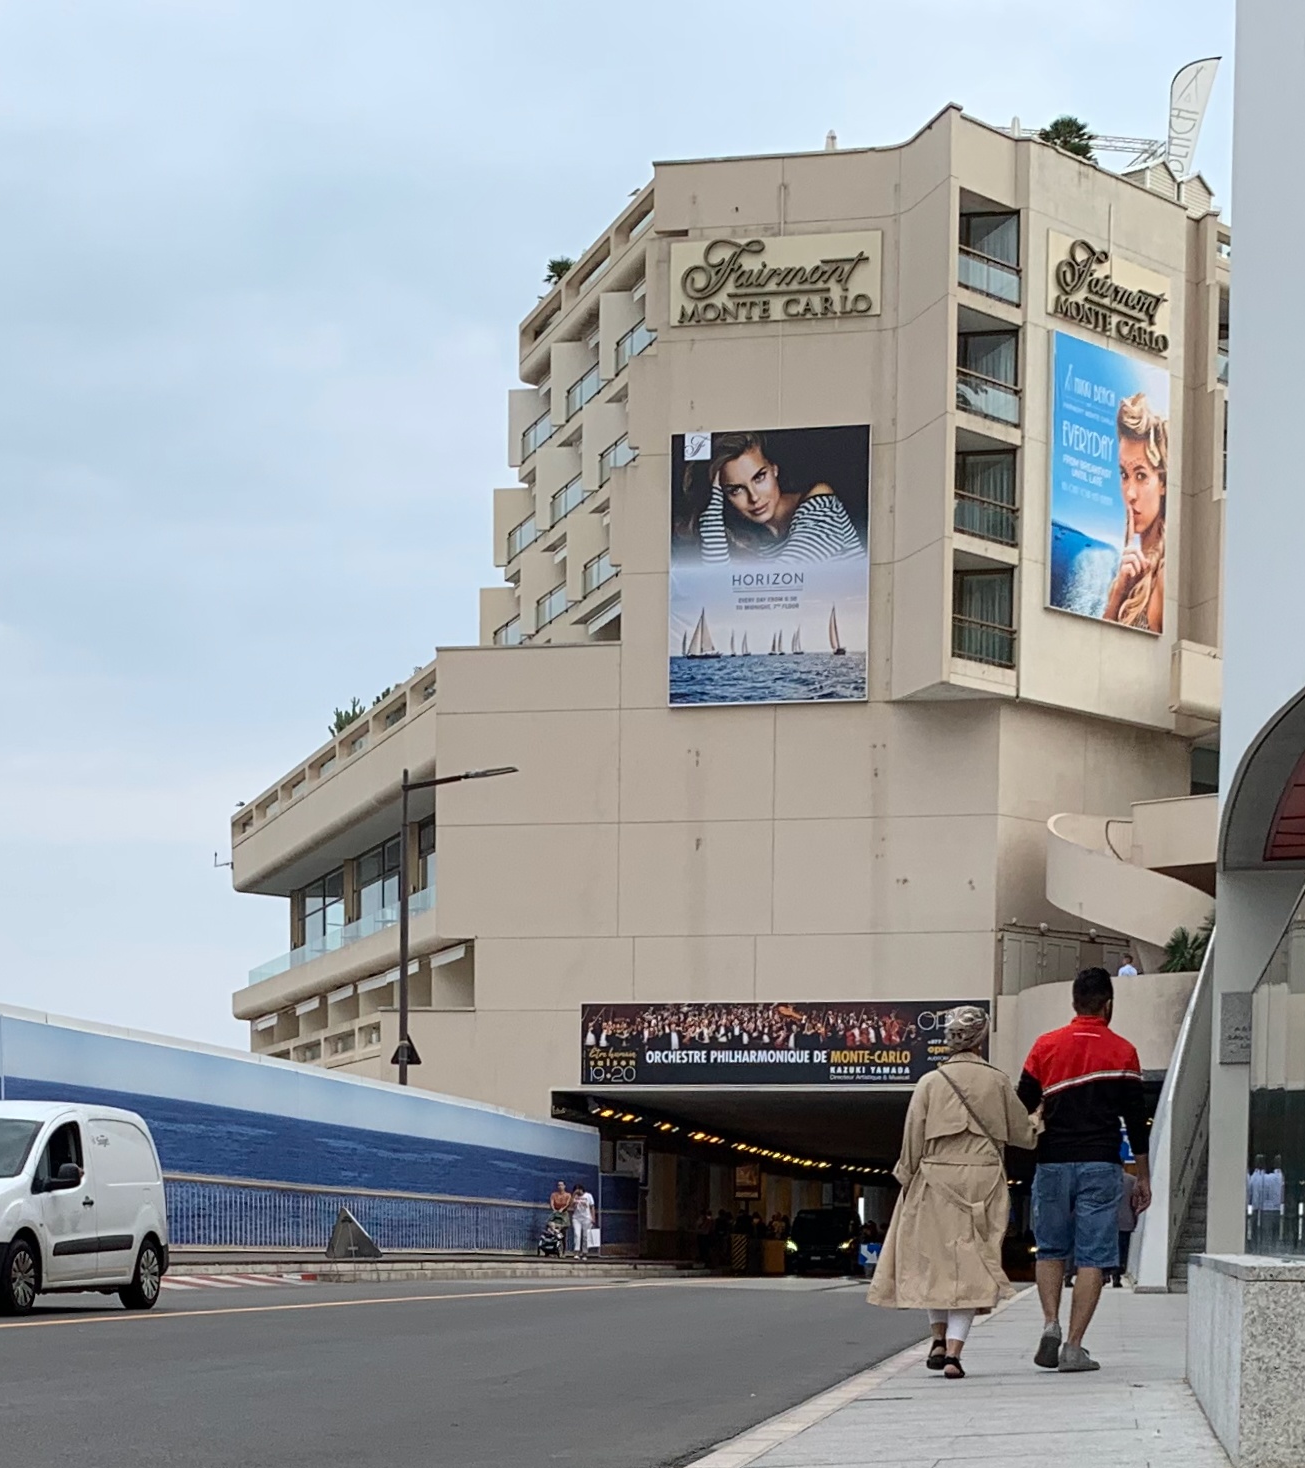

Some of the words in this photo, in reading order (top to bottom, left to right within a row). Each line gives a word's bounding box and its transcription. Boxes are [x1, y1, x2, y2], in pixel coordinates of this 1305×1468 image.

[681, 239, 870, 301] Fairmont
[1055, 239, 1170, 327] Fairmont
[677, 300, 771, 324] MONTE
[782, 293, 873, 318] CARLO
[1054, 294, 1112, 333] MONTE
[1115, 320, 1170, 353] CARLO
[1062, 419, 1115, 462] EVERYDAY
[732, 572, 804, 586] HORIZON
[589, 1058, 636, 1067] saison
[645, 1050, 707, 1064] ORCHESTRE
[709, 1050, 811, 1064] PHILHARMONIQUE
[812, 1050, 827, 1064] DE
[830, 1050, 911, 1064] MONTE-CARLO
[829, 1066, 866, 1074] KAZUKI
[870, 1066, 911, 1074] YAMADA
